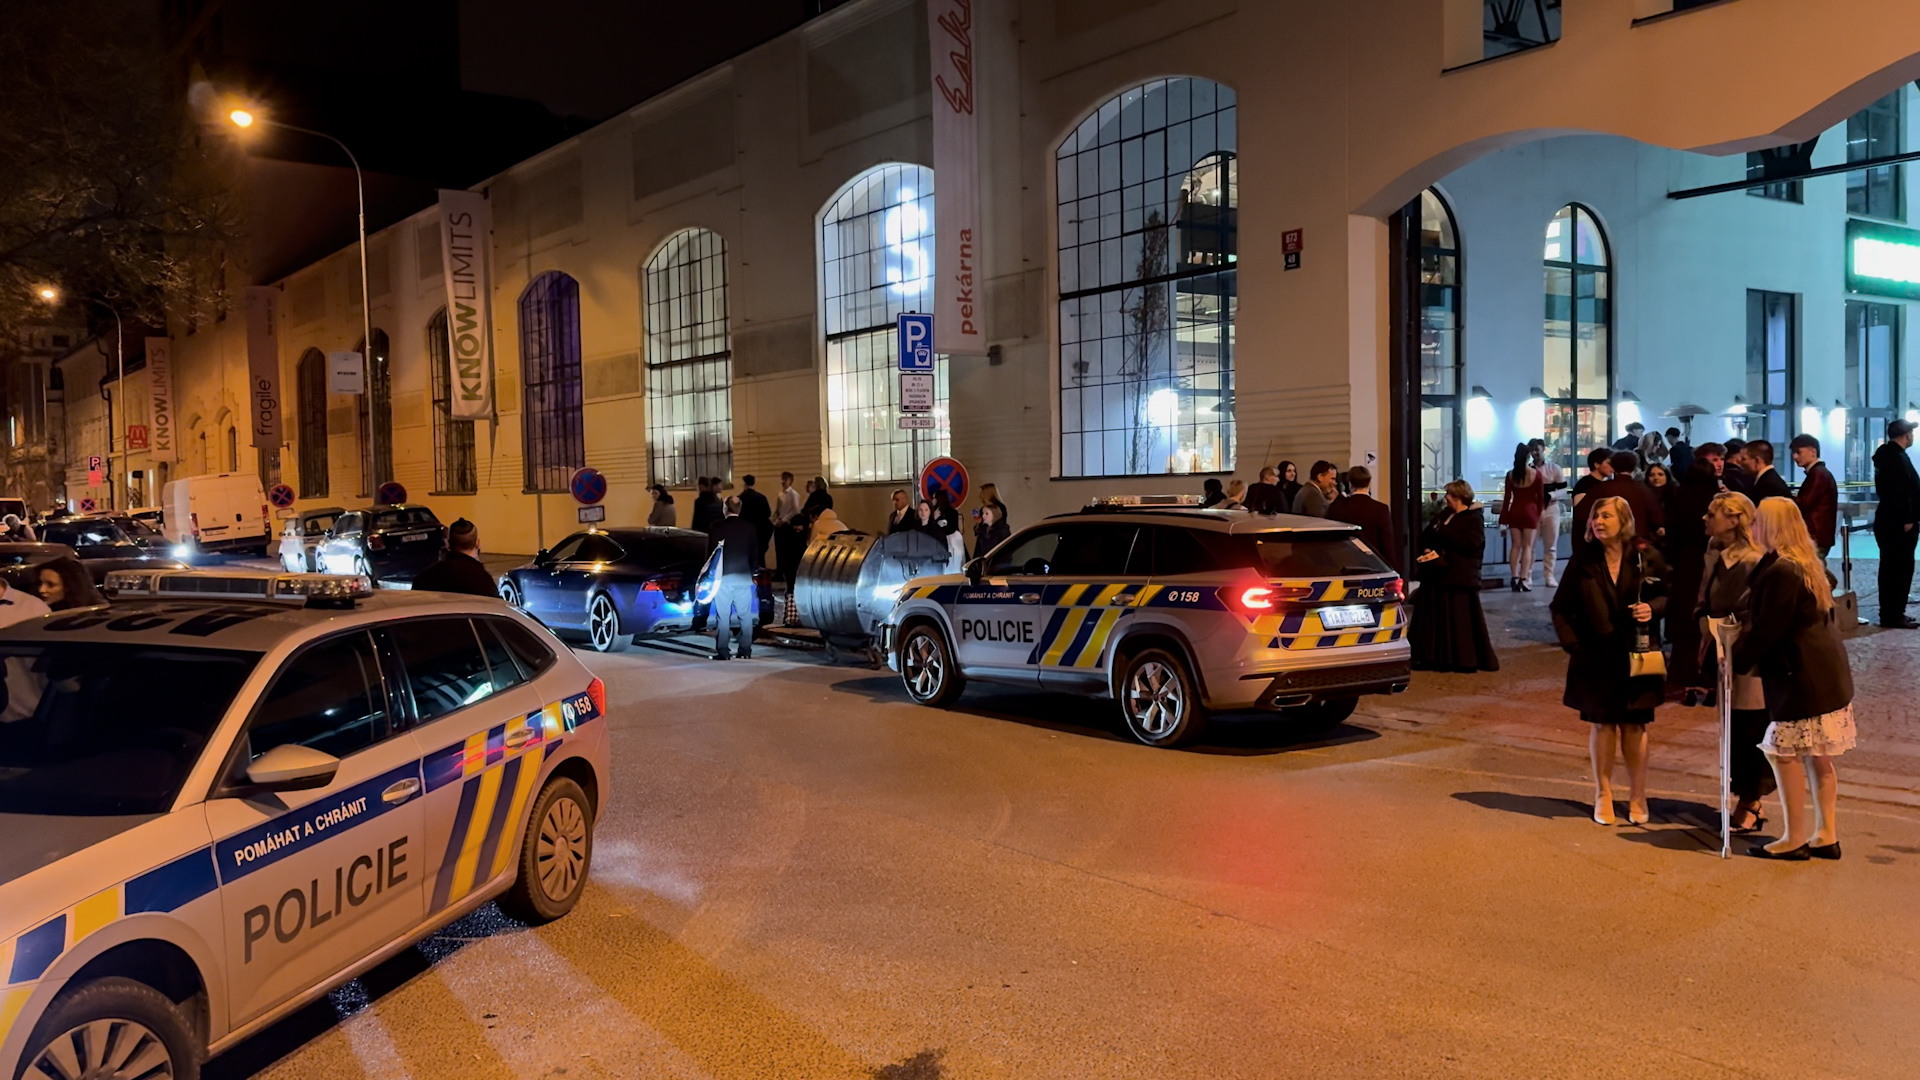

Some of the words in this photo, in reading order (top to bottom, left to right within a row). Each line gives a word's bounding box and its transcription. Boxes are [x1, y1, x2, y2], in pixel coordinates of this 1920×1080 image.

[450, 212, 483, 401] KNOWLIMITS
[956, 228, 978, 335] pekárna
[906, 320, 927, 353] P
[151, 349, 171, 451] KNOWLIMITS
[257, 379, 277, 436] fragile
[1179, 591, 1200, 602] 158
[1357, 588, 1384, 598] POLICIE
[962, 619, 1034, 643] POLICIE
[574, 696, 592, 716] 158
[234, 825, 301, 867] POMÁHAT
[304, 821, 315, 837] A
[315, 797, 367, 831] CHRÁNIT
[244, 835, 408, 965] POLICIE
